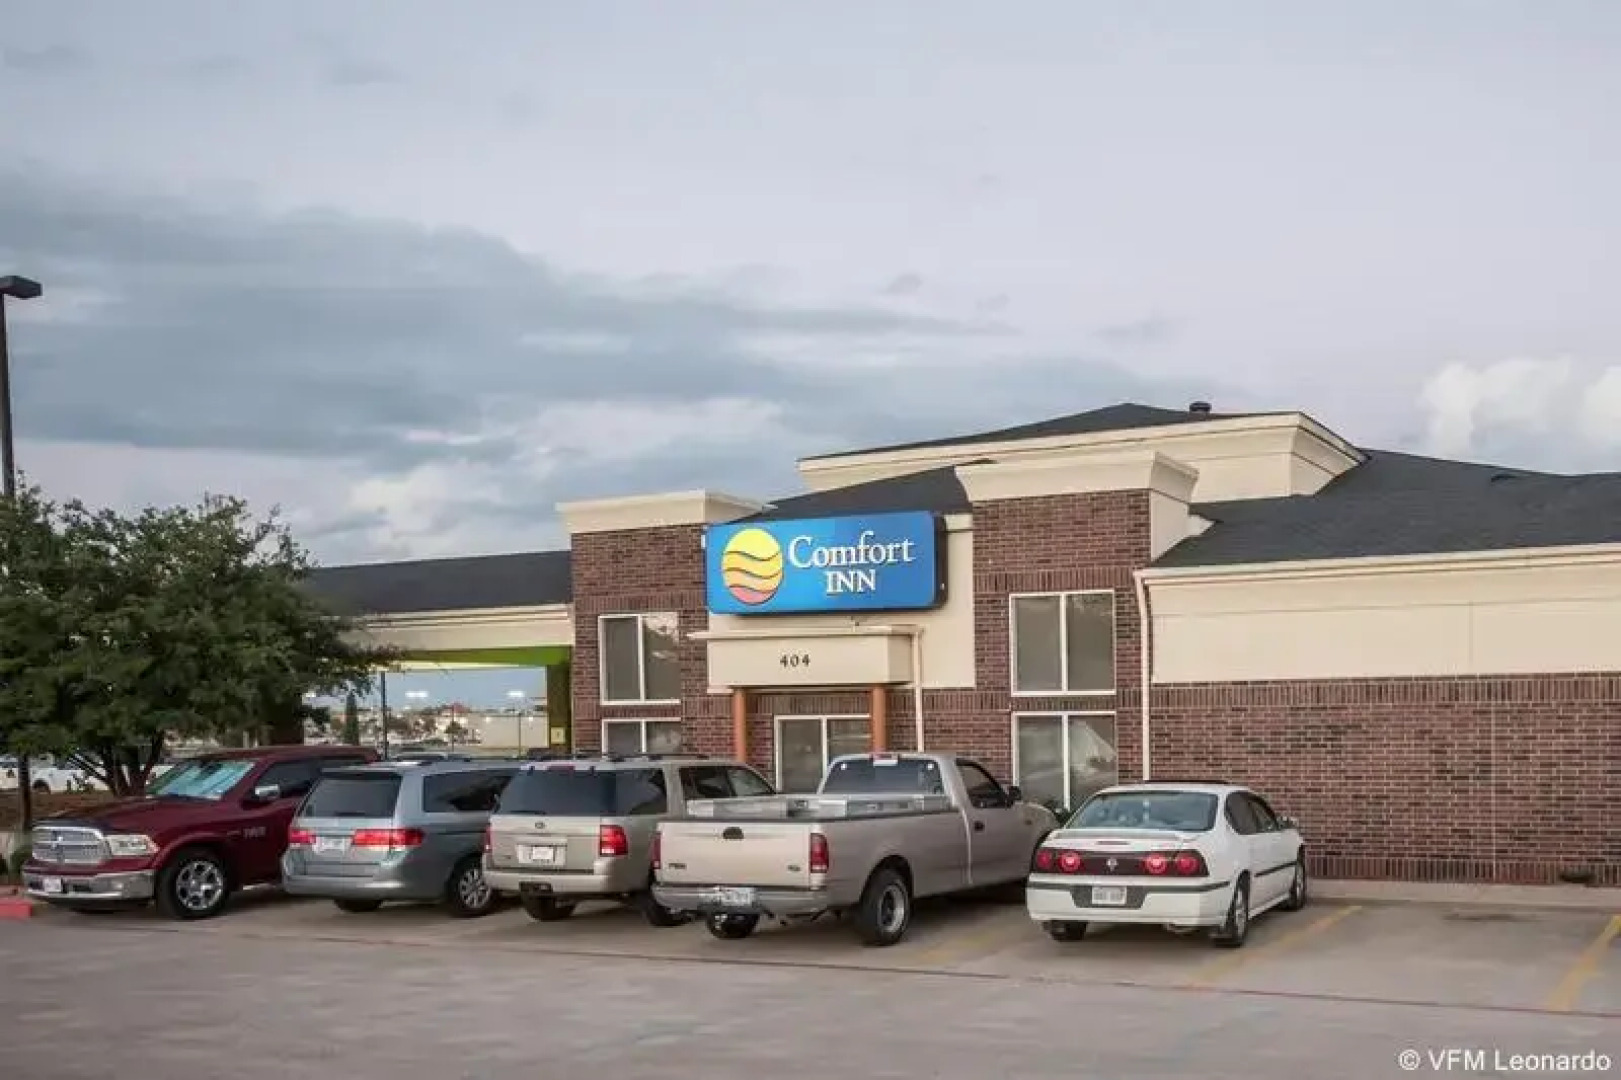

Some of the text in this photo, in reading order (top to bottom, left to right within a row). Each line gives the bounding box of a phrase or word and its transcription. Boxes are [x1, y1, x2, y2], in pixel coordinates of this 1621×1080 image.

[788, 531, 916, 568] Comfort
[825, 569, 877, 594] INN
[779, 654, 811, 668] 404
